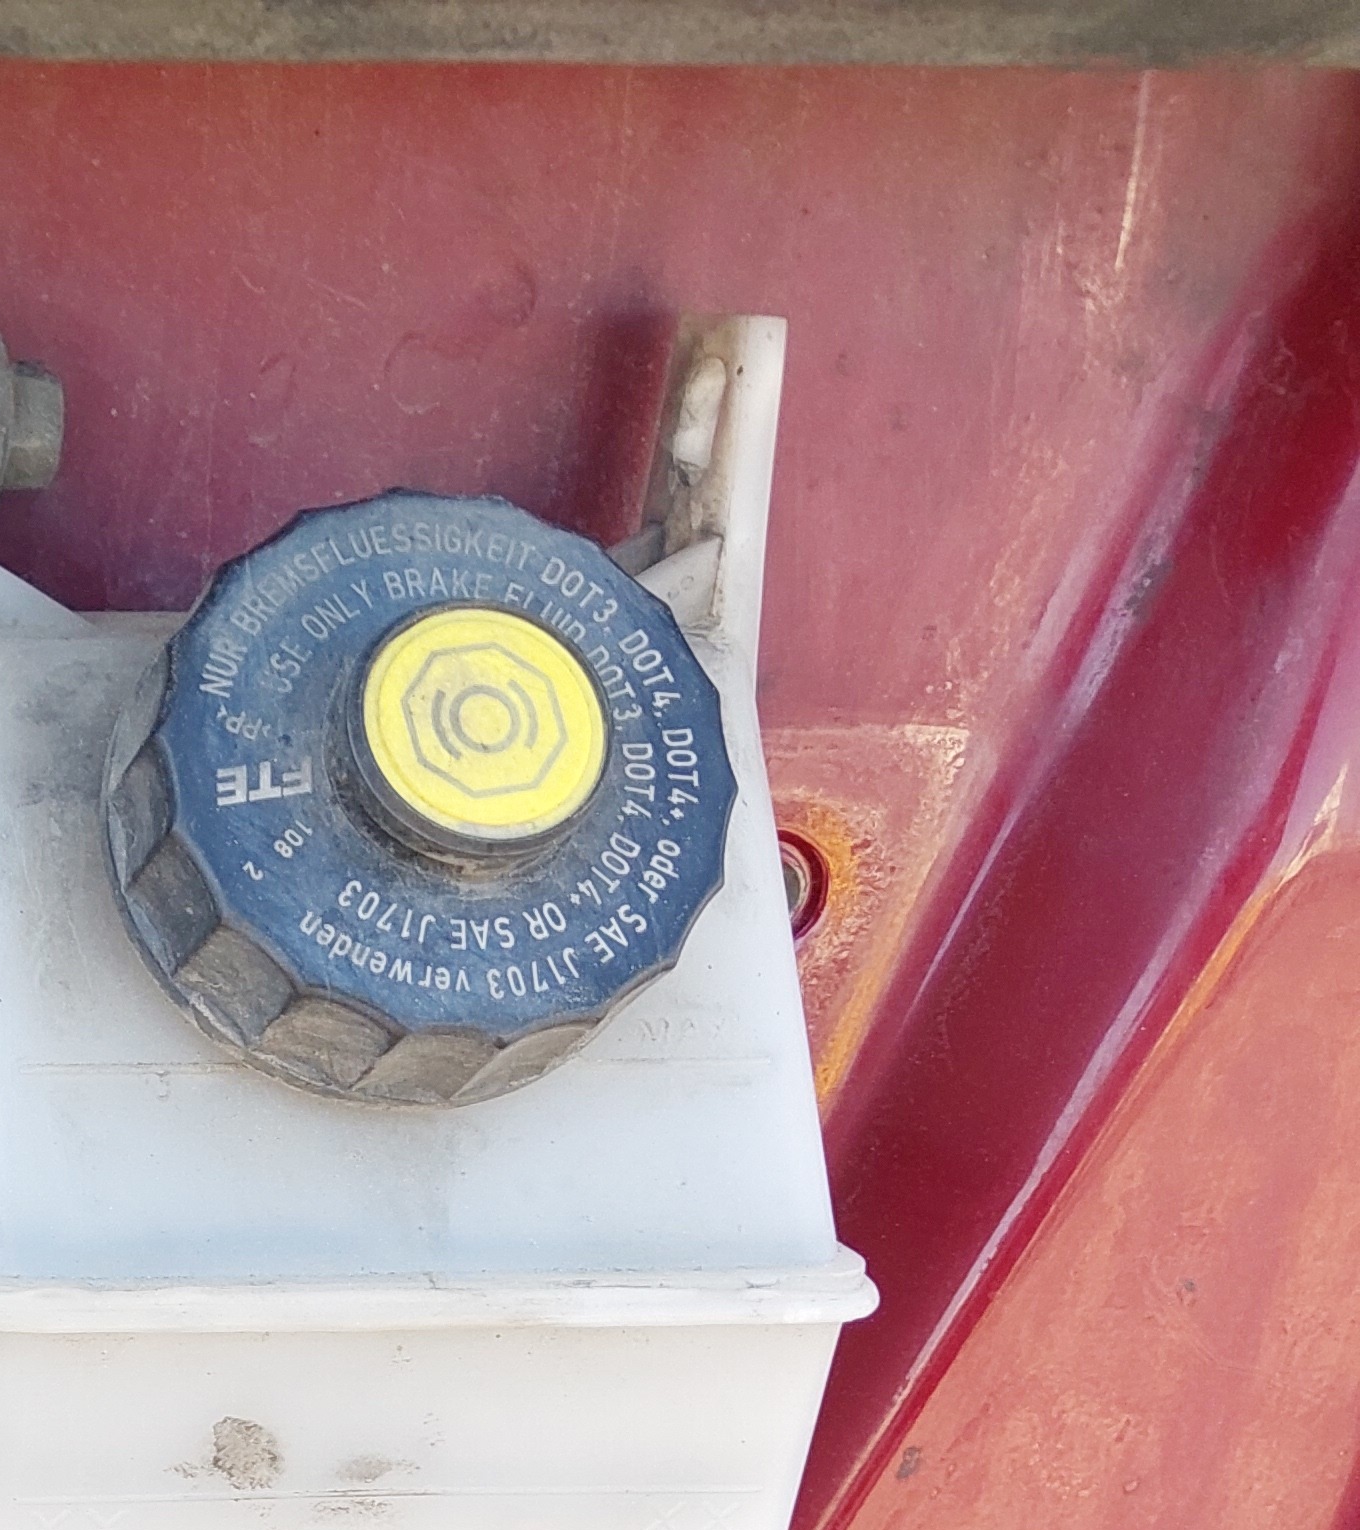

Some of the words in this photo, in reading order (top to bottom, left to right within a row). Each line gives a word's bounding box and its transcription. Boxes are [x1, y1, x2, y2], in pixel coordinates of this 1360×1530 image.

[230, 521, 536, 637] BREMSFLUESSIGKEIT
[301, 578, 374, 641] ONLY
[382, 566, 493, 600] BRAKE
[198, 634, 248, 698] NUR
[216, 755, 312, 806] FTE
[638, 839, 681, 904] oder
[338, 880, 437, 944] J1703
[450, 917, 516, 951] SAE
[522, 902, 567, 941] OR
[584, 903, 647, 964] SAE
[299, 910, 471, 992] verwenden
[487, 947, 580, 1000] J1703
